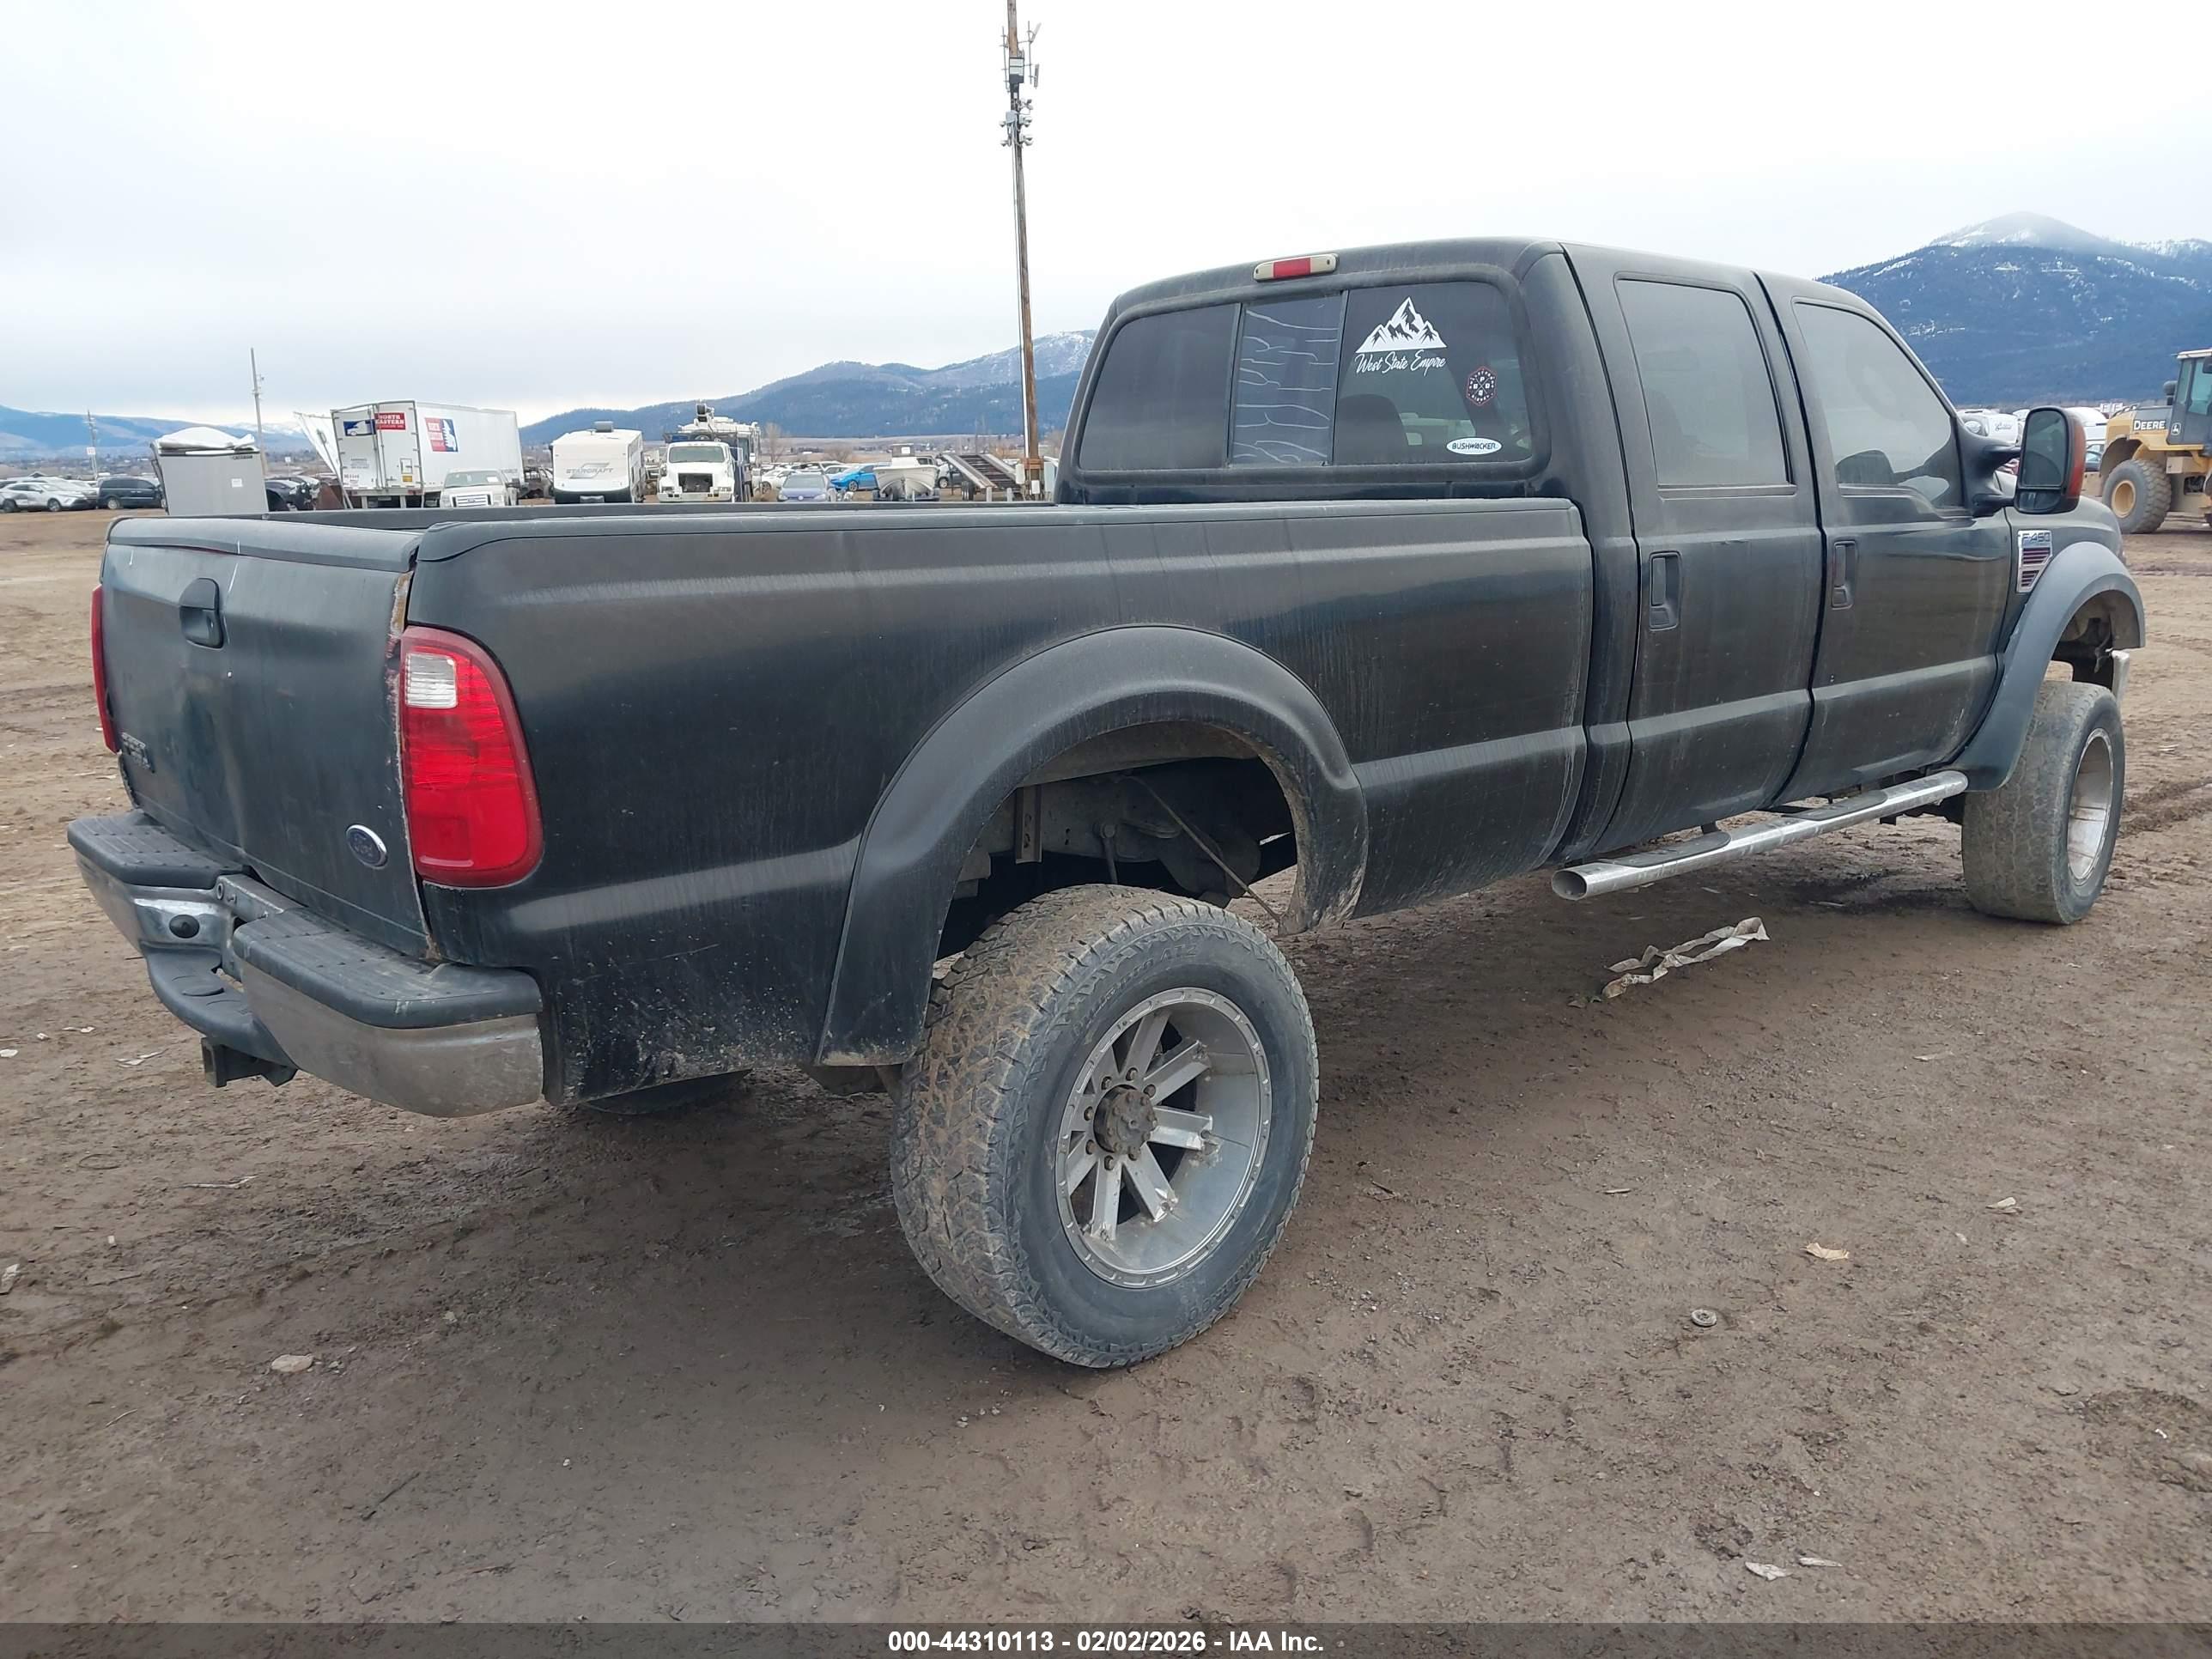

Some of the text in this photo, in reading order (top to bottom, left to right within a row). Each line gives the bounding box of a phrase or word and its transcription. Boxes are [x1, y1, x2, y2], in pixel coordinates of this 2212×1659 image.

[1355, 349, 1447, 376] West State Empire
[2134, 420, 2166, 430] DEERE
